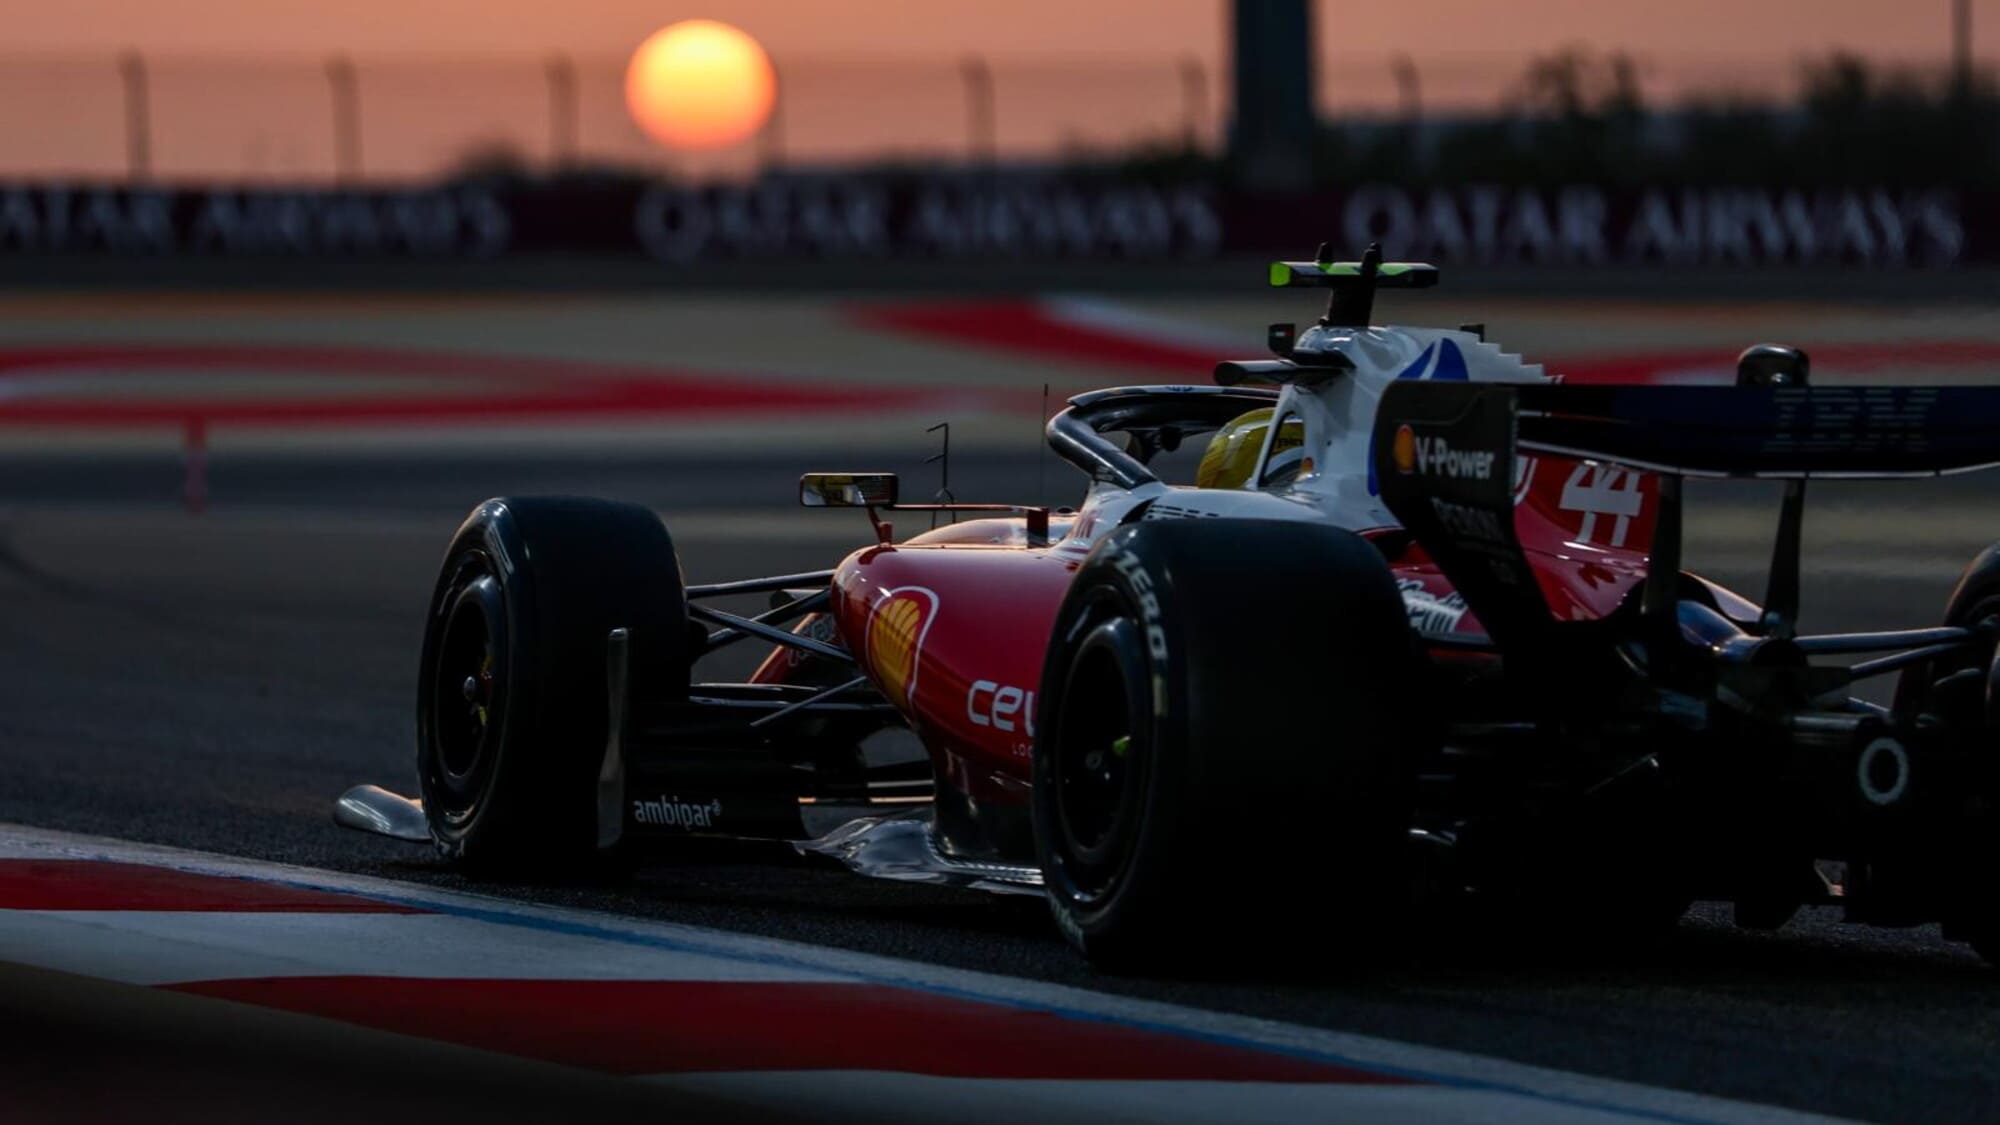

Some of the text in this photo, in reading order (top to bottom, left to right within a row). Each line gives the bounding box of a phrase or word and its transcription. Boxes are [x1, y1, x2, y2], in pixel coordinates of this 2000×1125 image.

[200, 186, 512, 252] AIRWAYS
[634, 182, 1223, 260] QATAR AIRWAYS
[1342, 184, 1964, 264] QATAR AIRWAYS
[1761, 386, 1941, 454] IBM
[1415, 435, 1495, 480] V-Power
[1558, 458, 1643, 548] 44
[1114, 550, 1169, 661] ZERO
[632, 794, 713, 832] ambipar
